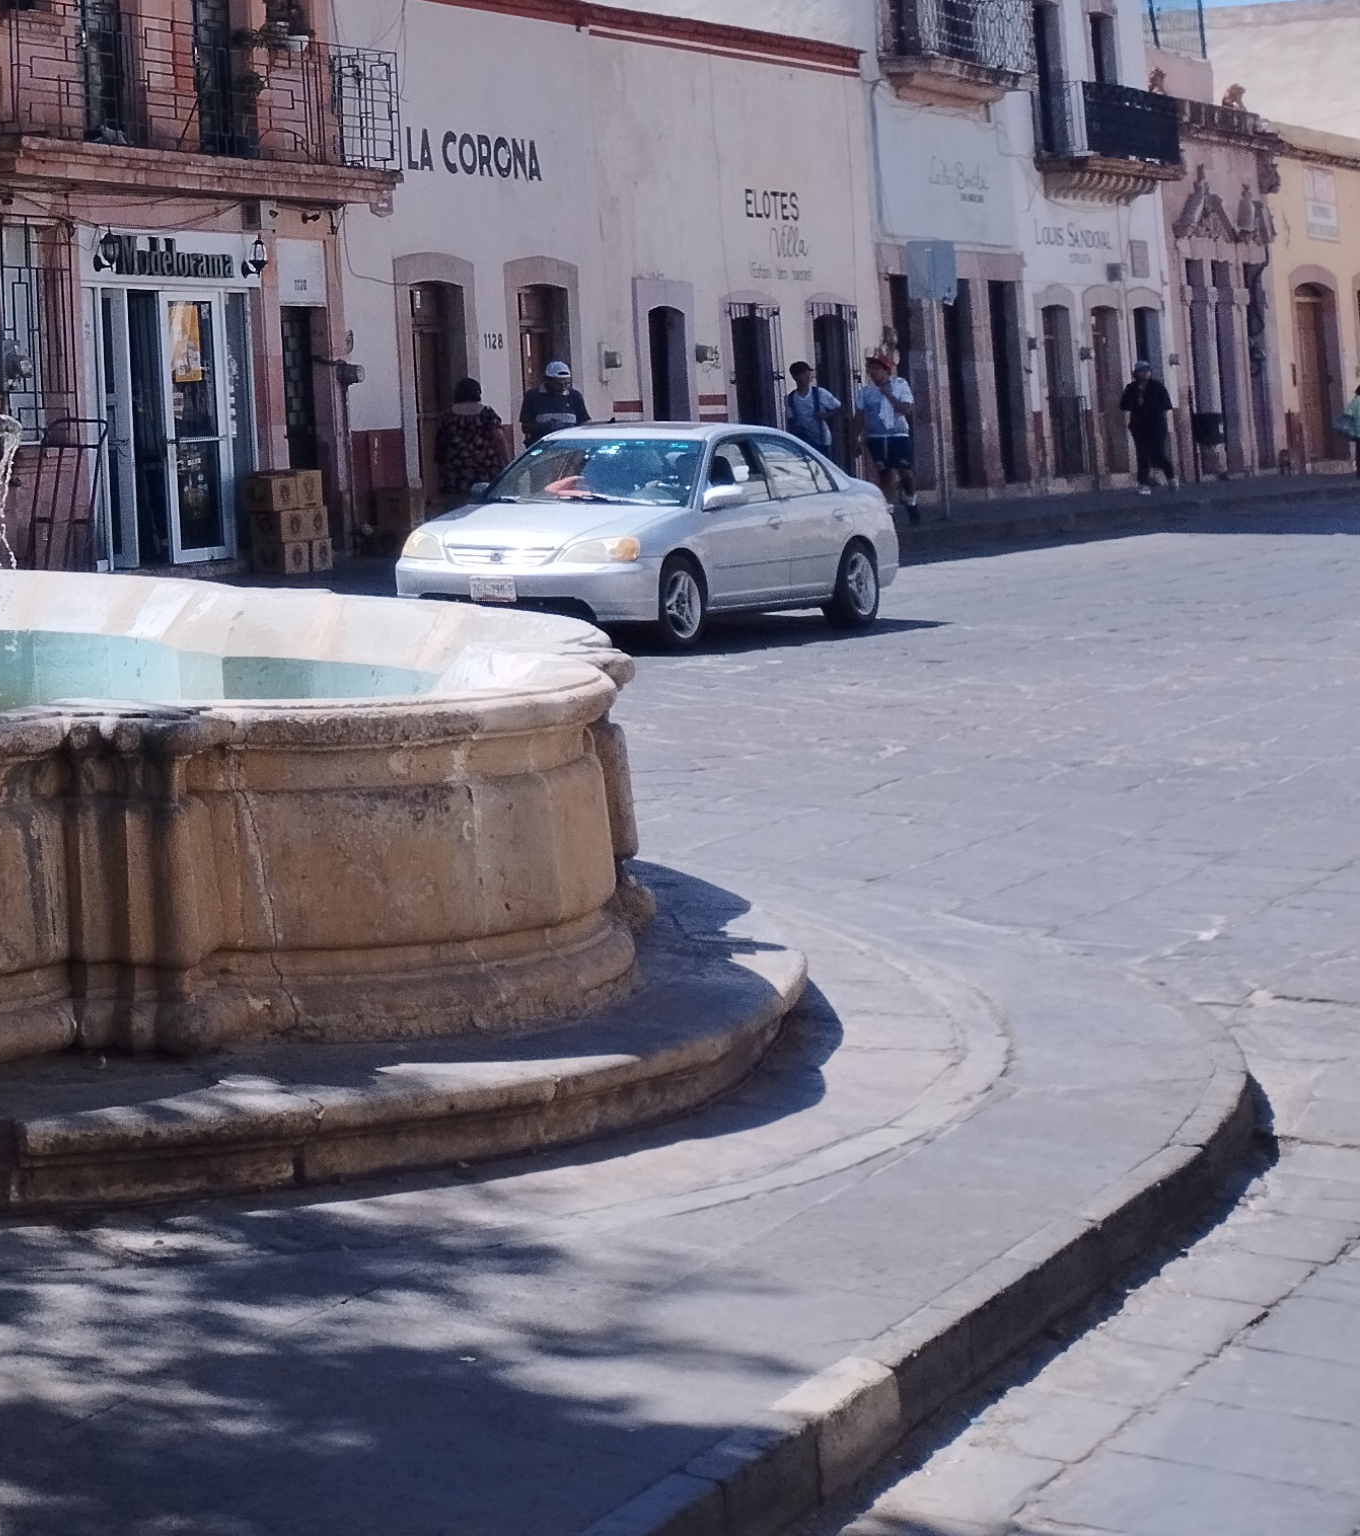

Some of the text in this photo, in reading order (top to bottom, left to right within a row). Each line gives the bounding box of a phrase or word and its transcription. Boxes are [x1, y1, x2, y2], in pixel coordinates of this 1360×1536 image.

[406, 126, 542, 182] LA CORONA
[744, 188, 800, 221] ELOTES
[115, 234, 235, 279] Modelorama
[768, 225, 811, 258] Villa
[483, 332, 504, 350] 1128
